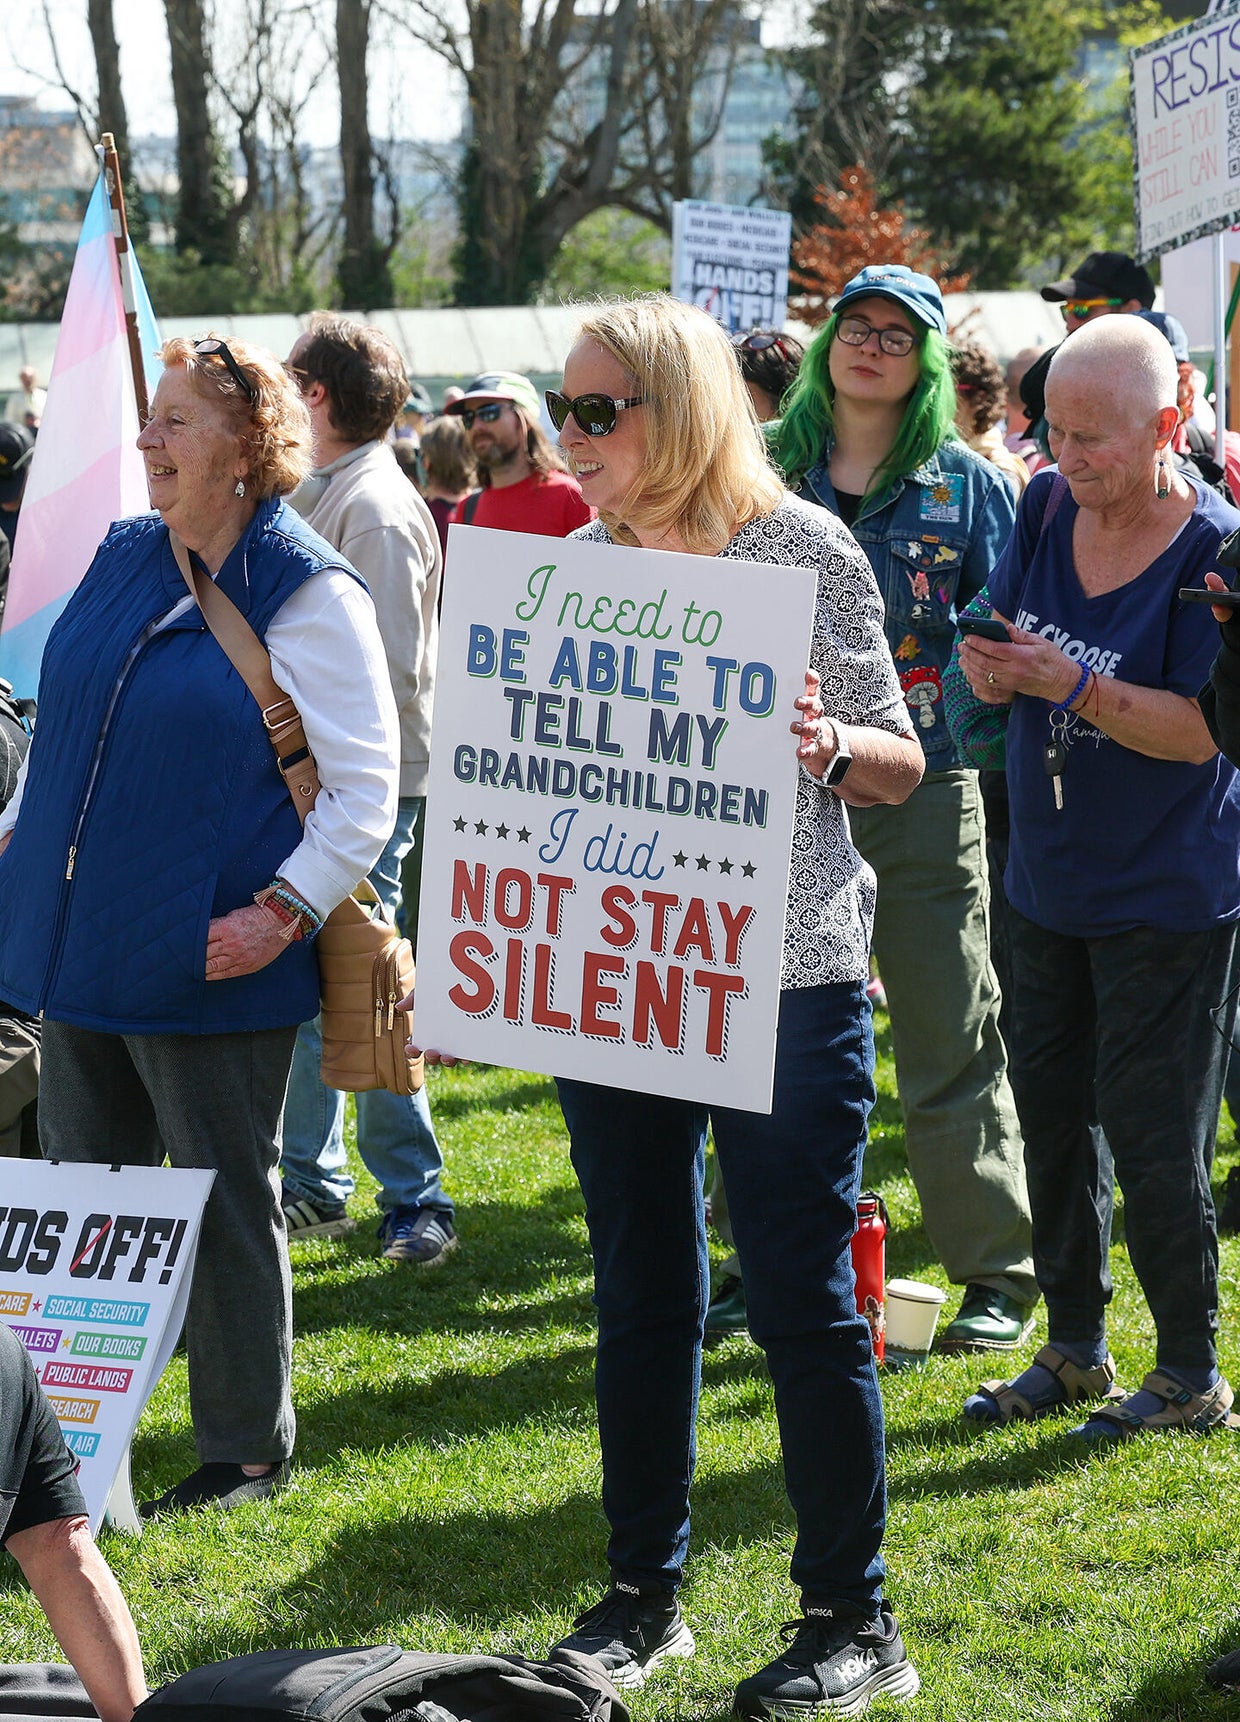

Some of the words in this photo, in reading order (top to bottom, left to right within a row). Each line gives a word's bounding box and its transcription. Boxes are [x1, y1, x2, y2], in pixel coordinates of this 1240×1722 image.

[1140, 118, 1182, 167] WHILE
[1187, 103, 1216, 146] YOU
[1142, 164, 1183, 208] STILL
[1189, 144, 1218, 186] CAN
[695, 262, 774, 296] HANDS
[515, 564, 557, 621] I
[557, 589, 672, 641] need
[681, 600, 723, 647] to
[466, 623, 529, 683] BE
[549, 636, 684, 704] ABLE
[706, 655, 777, 718] TO
[503, 686, 623, 758] TELL
[647, 708, 728, 770] MY
[452, 744, 770, 829] GRANDCHILDREN
[538, 808, 580, 864] I
[582, 824, 666, 880] did
[450, 859, 577, 939] NOT
[600, 885, 755, 970] STAY
[448, 930, 750, 1063] SILENT
[0, 1206, 69, 1275] DS
[69, 1212, 188, 1285] OFF!
[47, 1297, 88, 1319] SOCIAL
[90, 1300, 146, 1324] SECURITY
[46, 1365, 88, 1387] PUBLIC
[89, 1369, 128, 1390] LANDS
[75, 1334, 99, 1352] OUR
[100, 1337, 142, 1357] BOOKS
[48, 1398, 95, 1420] SEARCH
[74, 1434, 95, 1453] AIR
[615, 1581, 640, 1596] HOKA
[806, 1607, 834, 1618] HOKA
[835, 1647, 880, 1685] HOKA
